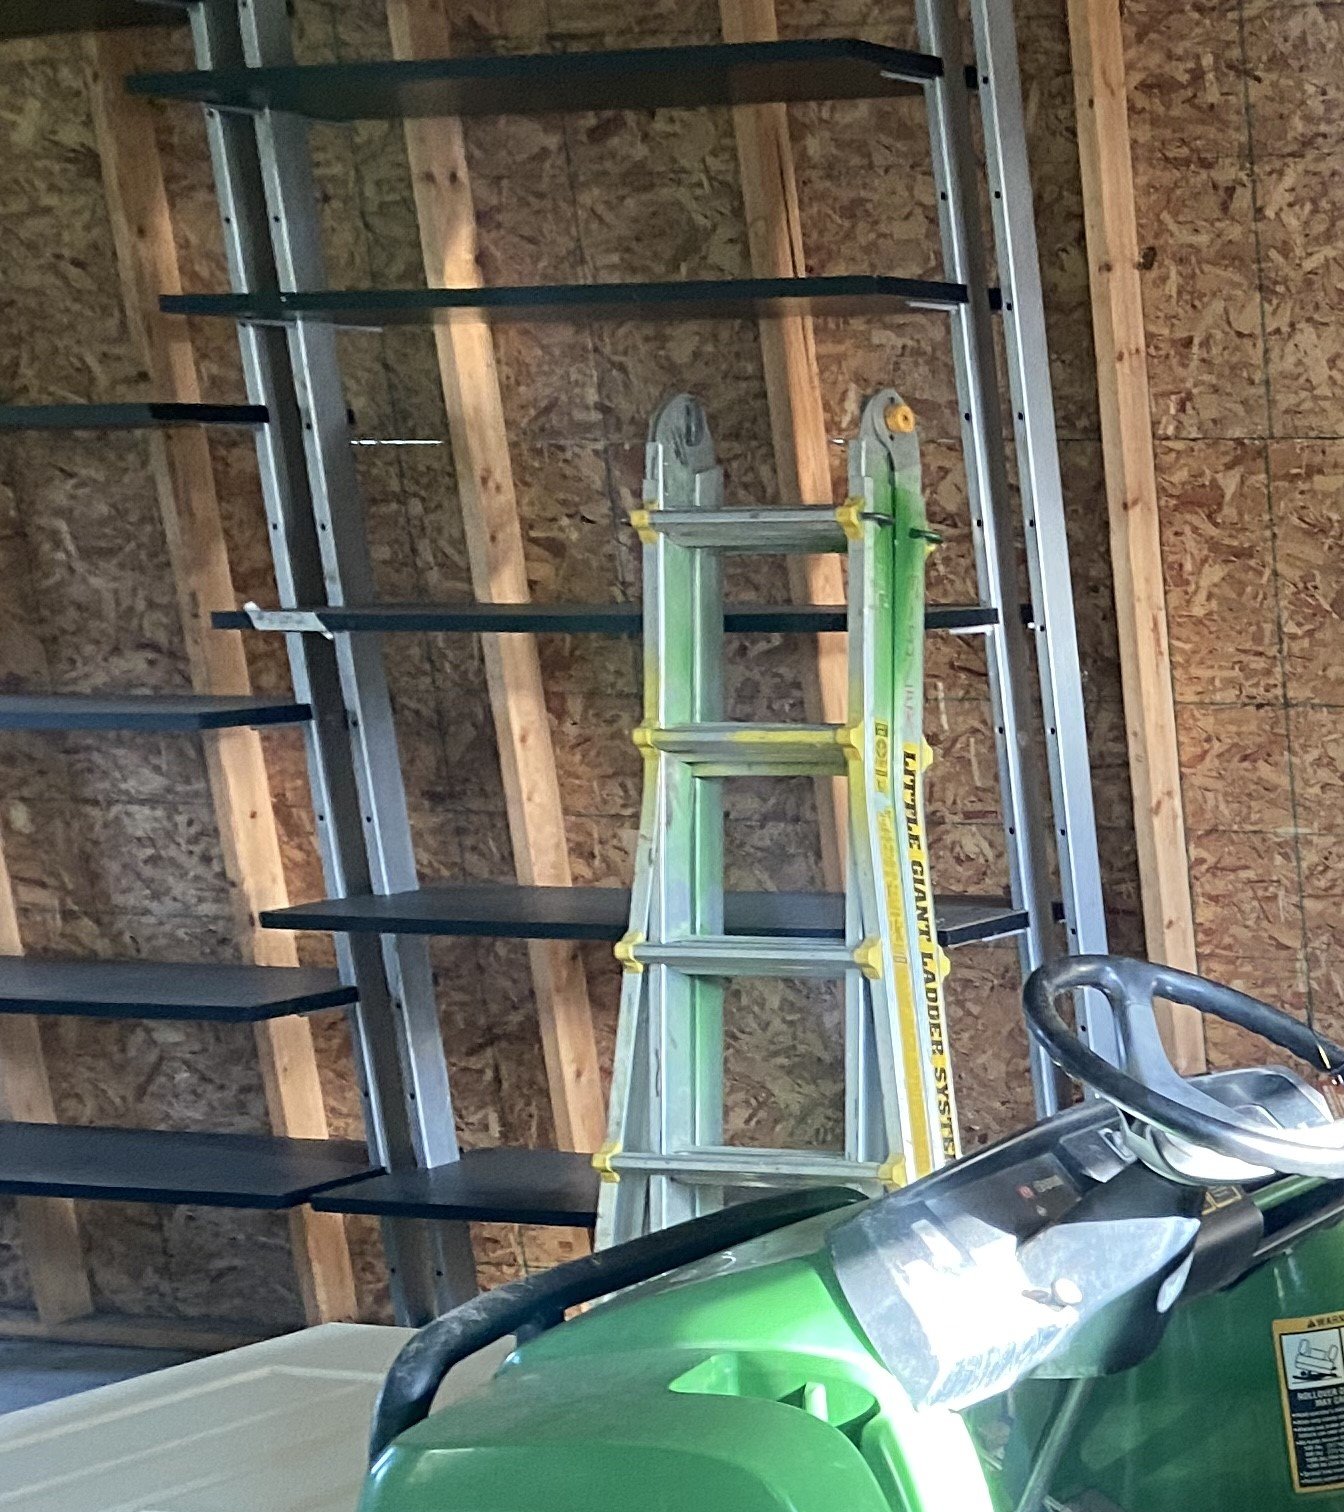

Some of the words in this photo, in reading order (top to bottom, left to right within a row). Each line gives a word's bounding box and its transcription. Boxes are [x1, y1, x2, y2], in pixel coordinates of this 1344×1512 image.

[903, 750, 921, 850] LITTLE
[911, 860, 932, 942] GIANT
[920, 952, 943, 1056] LADDER
